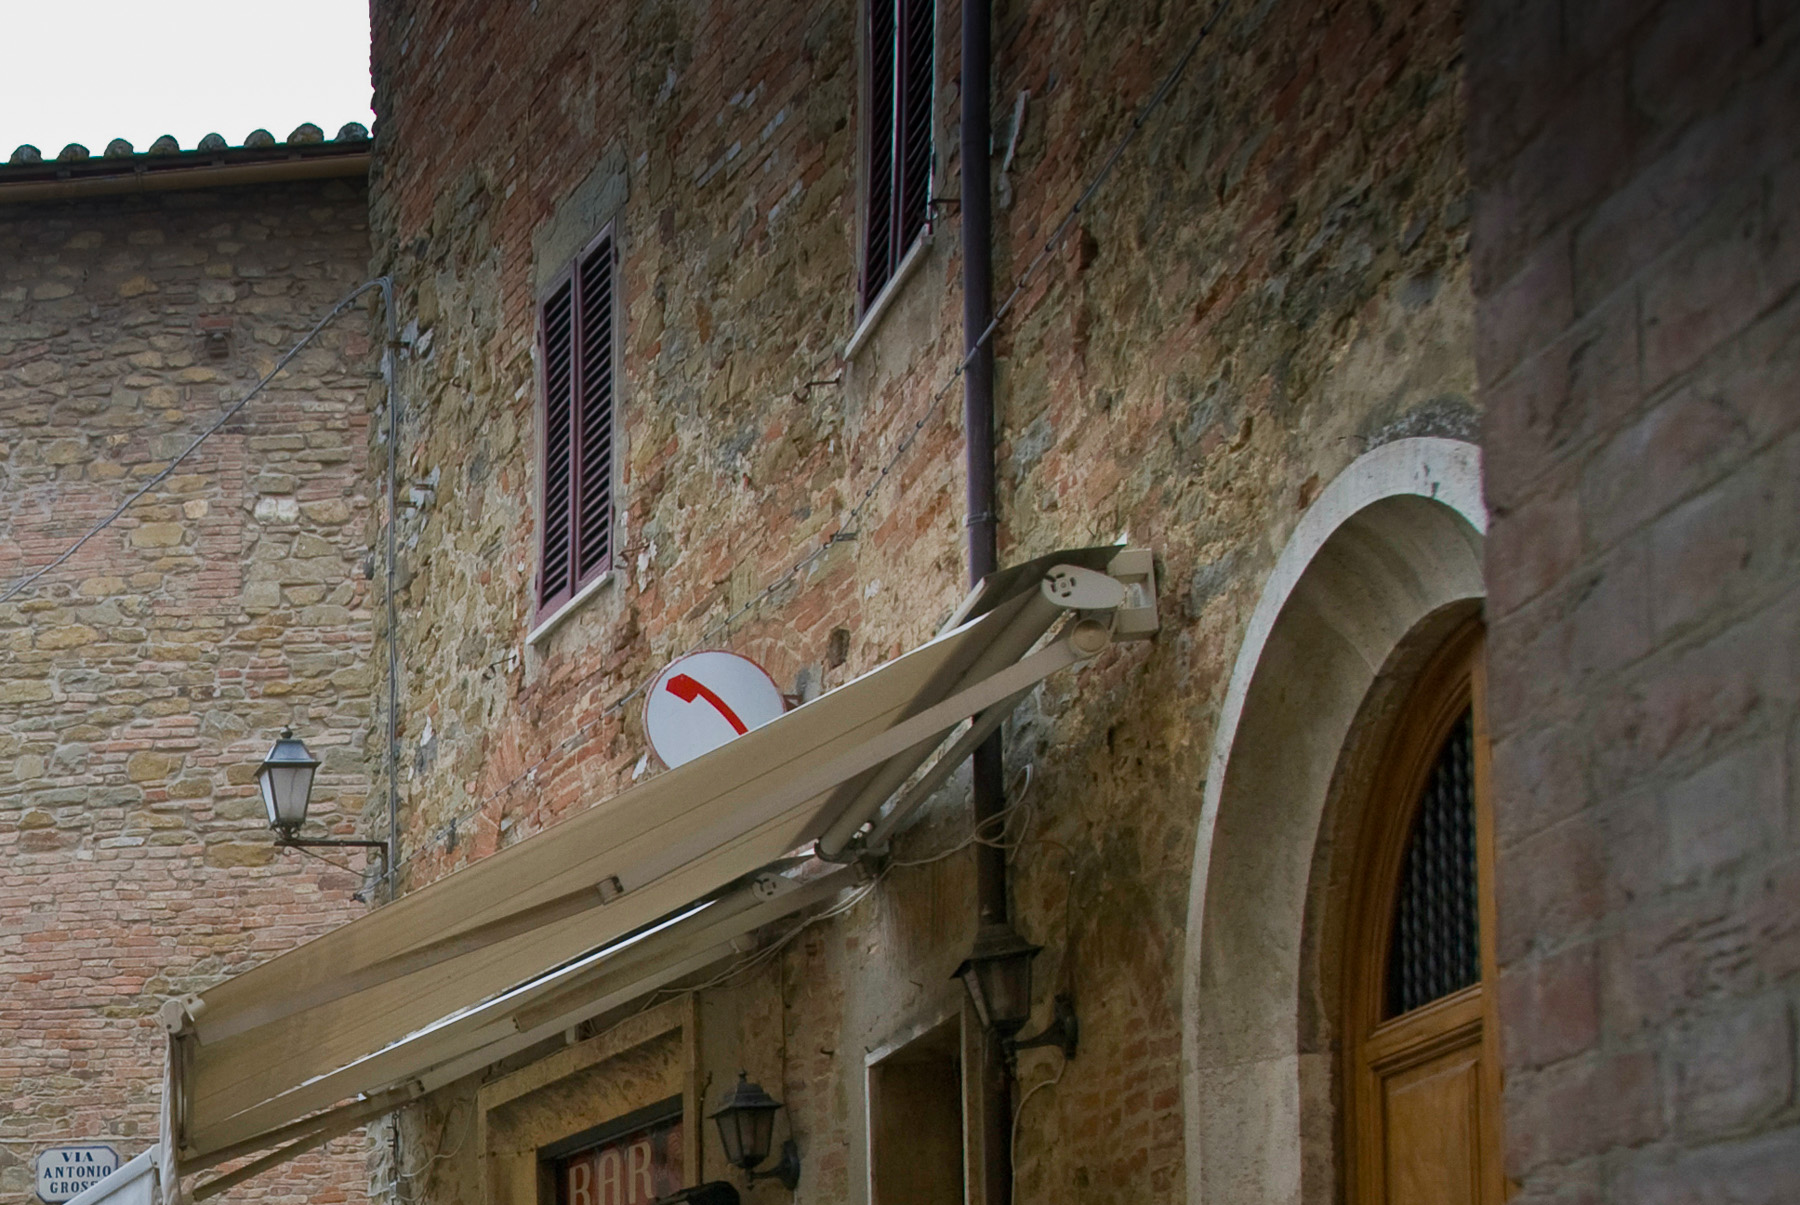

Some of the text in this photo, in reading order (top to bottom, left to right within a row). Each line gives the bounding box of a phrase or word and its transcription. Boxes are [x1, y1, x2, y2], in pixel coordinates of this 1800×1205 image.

[61, 1151, 94, 1163] VIA
[43, 1165, 112, 1179] ANTONIO
[49, 1180, 99, 1194] GROS
